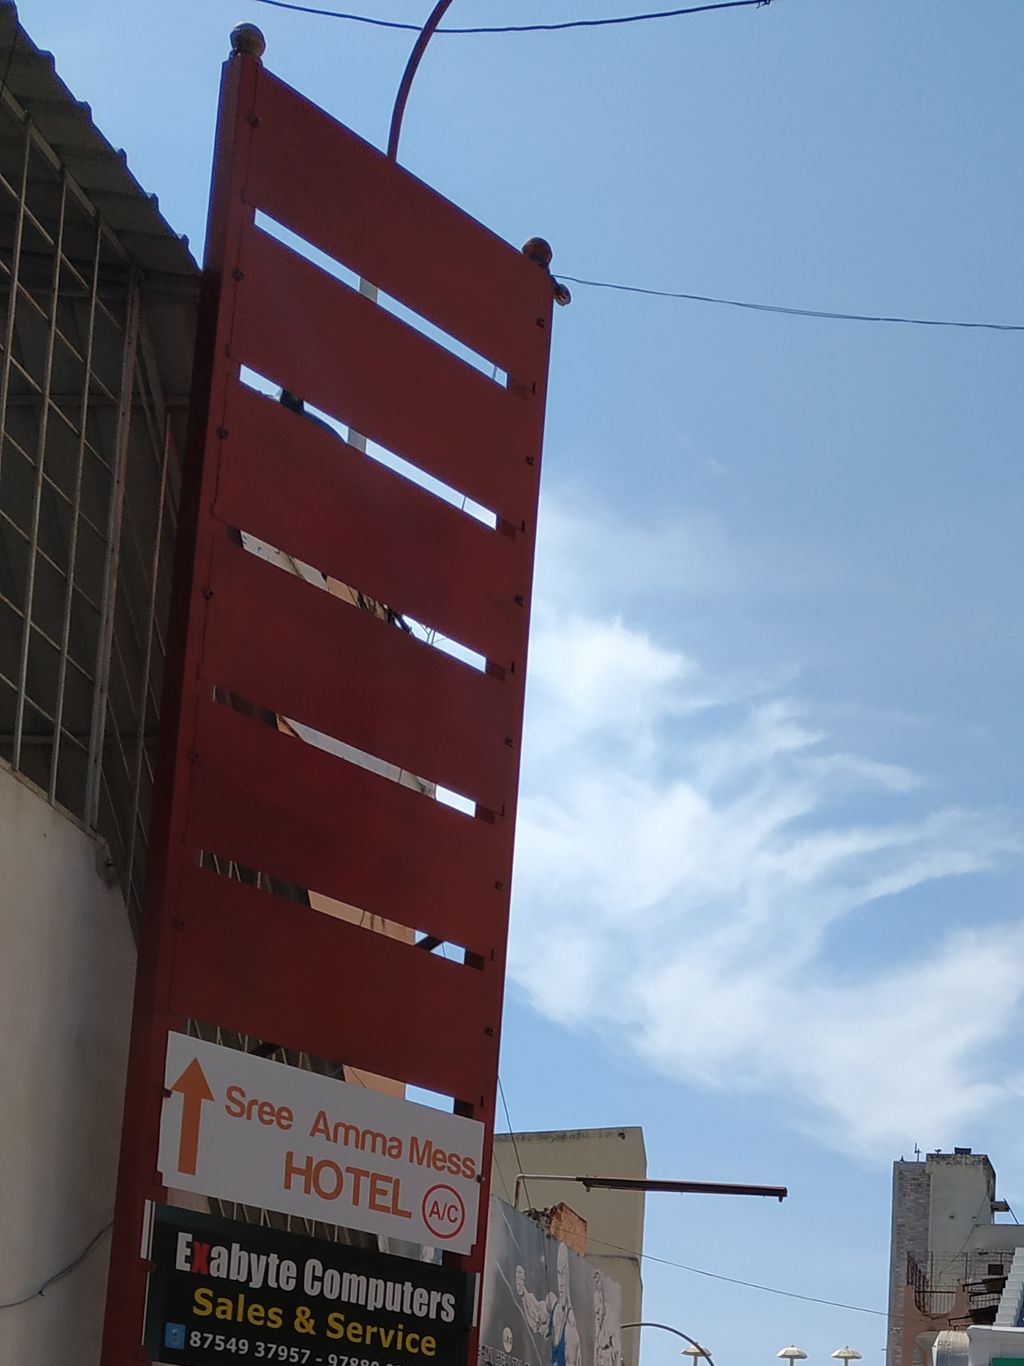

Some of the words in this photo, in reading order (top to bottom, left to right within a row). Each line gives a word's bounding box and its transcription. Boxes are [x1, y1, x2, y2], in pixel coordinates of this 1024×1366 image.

[225, 1084, 294, 1131] Sree
[309, 1110, 402, 1160] Amma
[408, 1135, 477, 1180] Mess
[283, 1150, 412, 1219] HOTEL
[428, 1199, 459, 1224] A/C
[176, 1231, 297, 1292] Exabyte
[303, 1258, 456, 1323] Computers
[189, 1331, 249, 1355] 87549
[254, 1341, 311, 1365] 37957
[192, 1287, 283, 1329] Sales
[294, 1306, 316, 1336] &
[326, 1311, 437, 1357] Service
